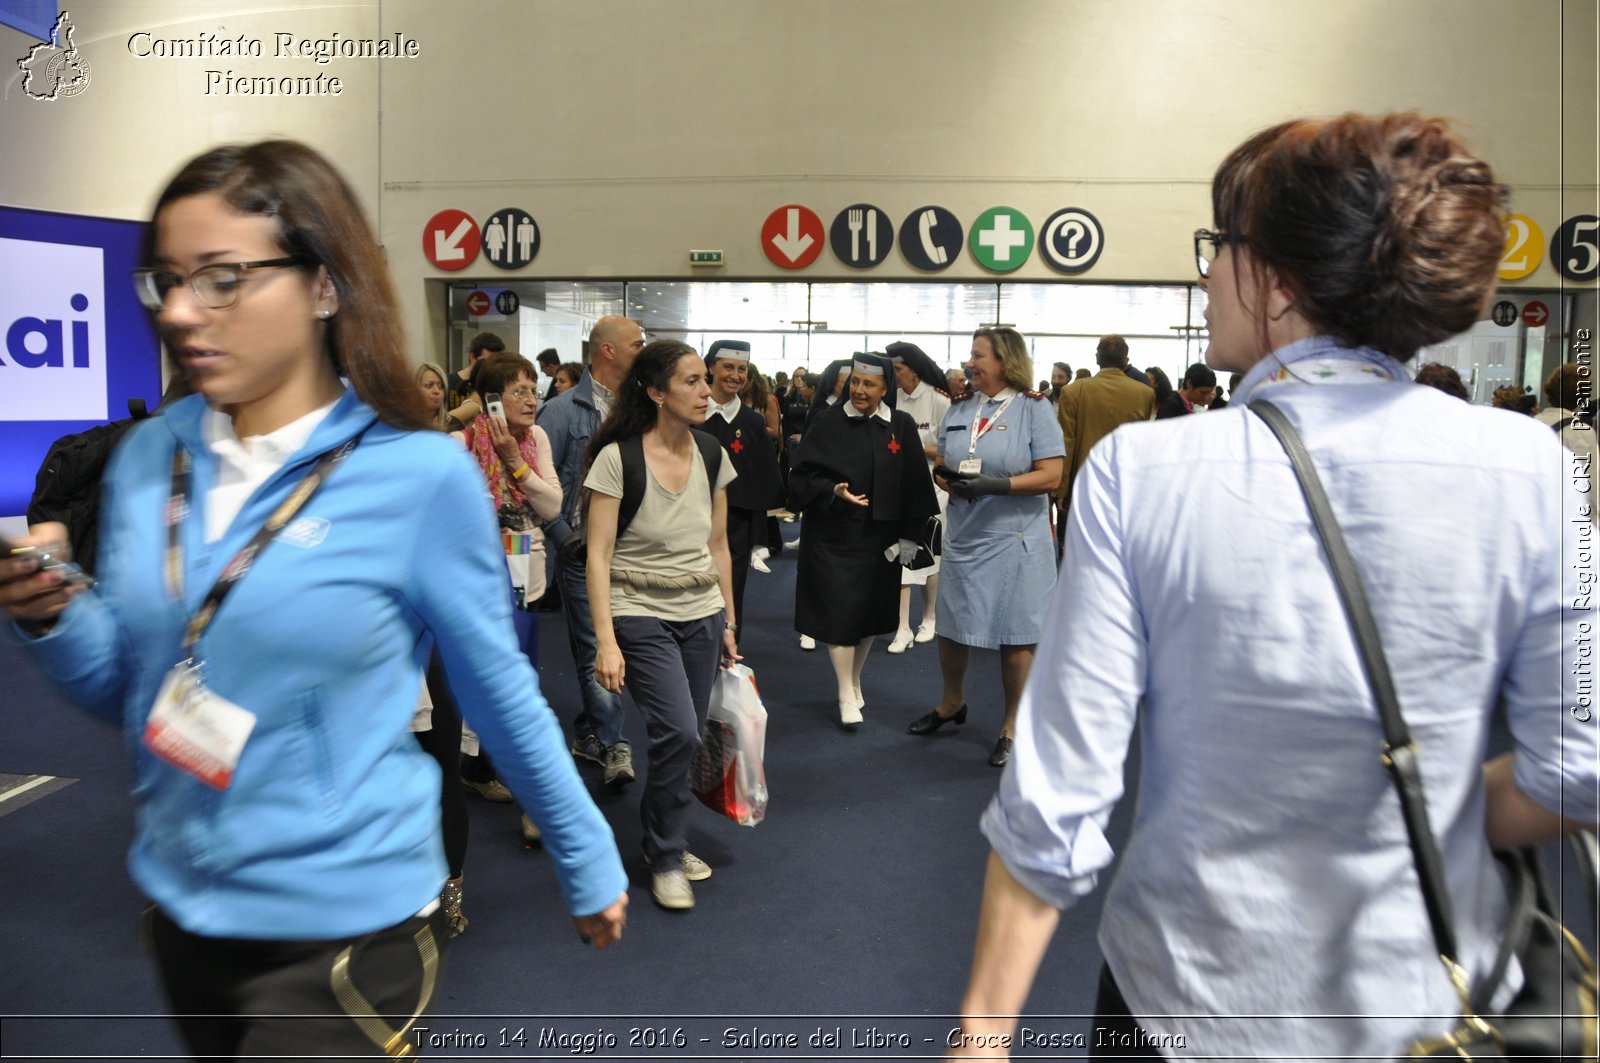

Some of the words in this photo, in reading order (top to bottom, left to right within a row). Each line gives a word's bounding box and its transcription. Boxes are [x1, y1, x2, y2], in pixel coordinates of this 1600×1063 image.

[1498, 219, 1530, 271] 2
[1567, 221, 1600, 274] 5
[0, 293, 90, 369] ai
